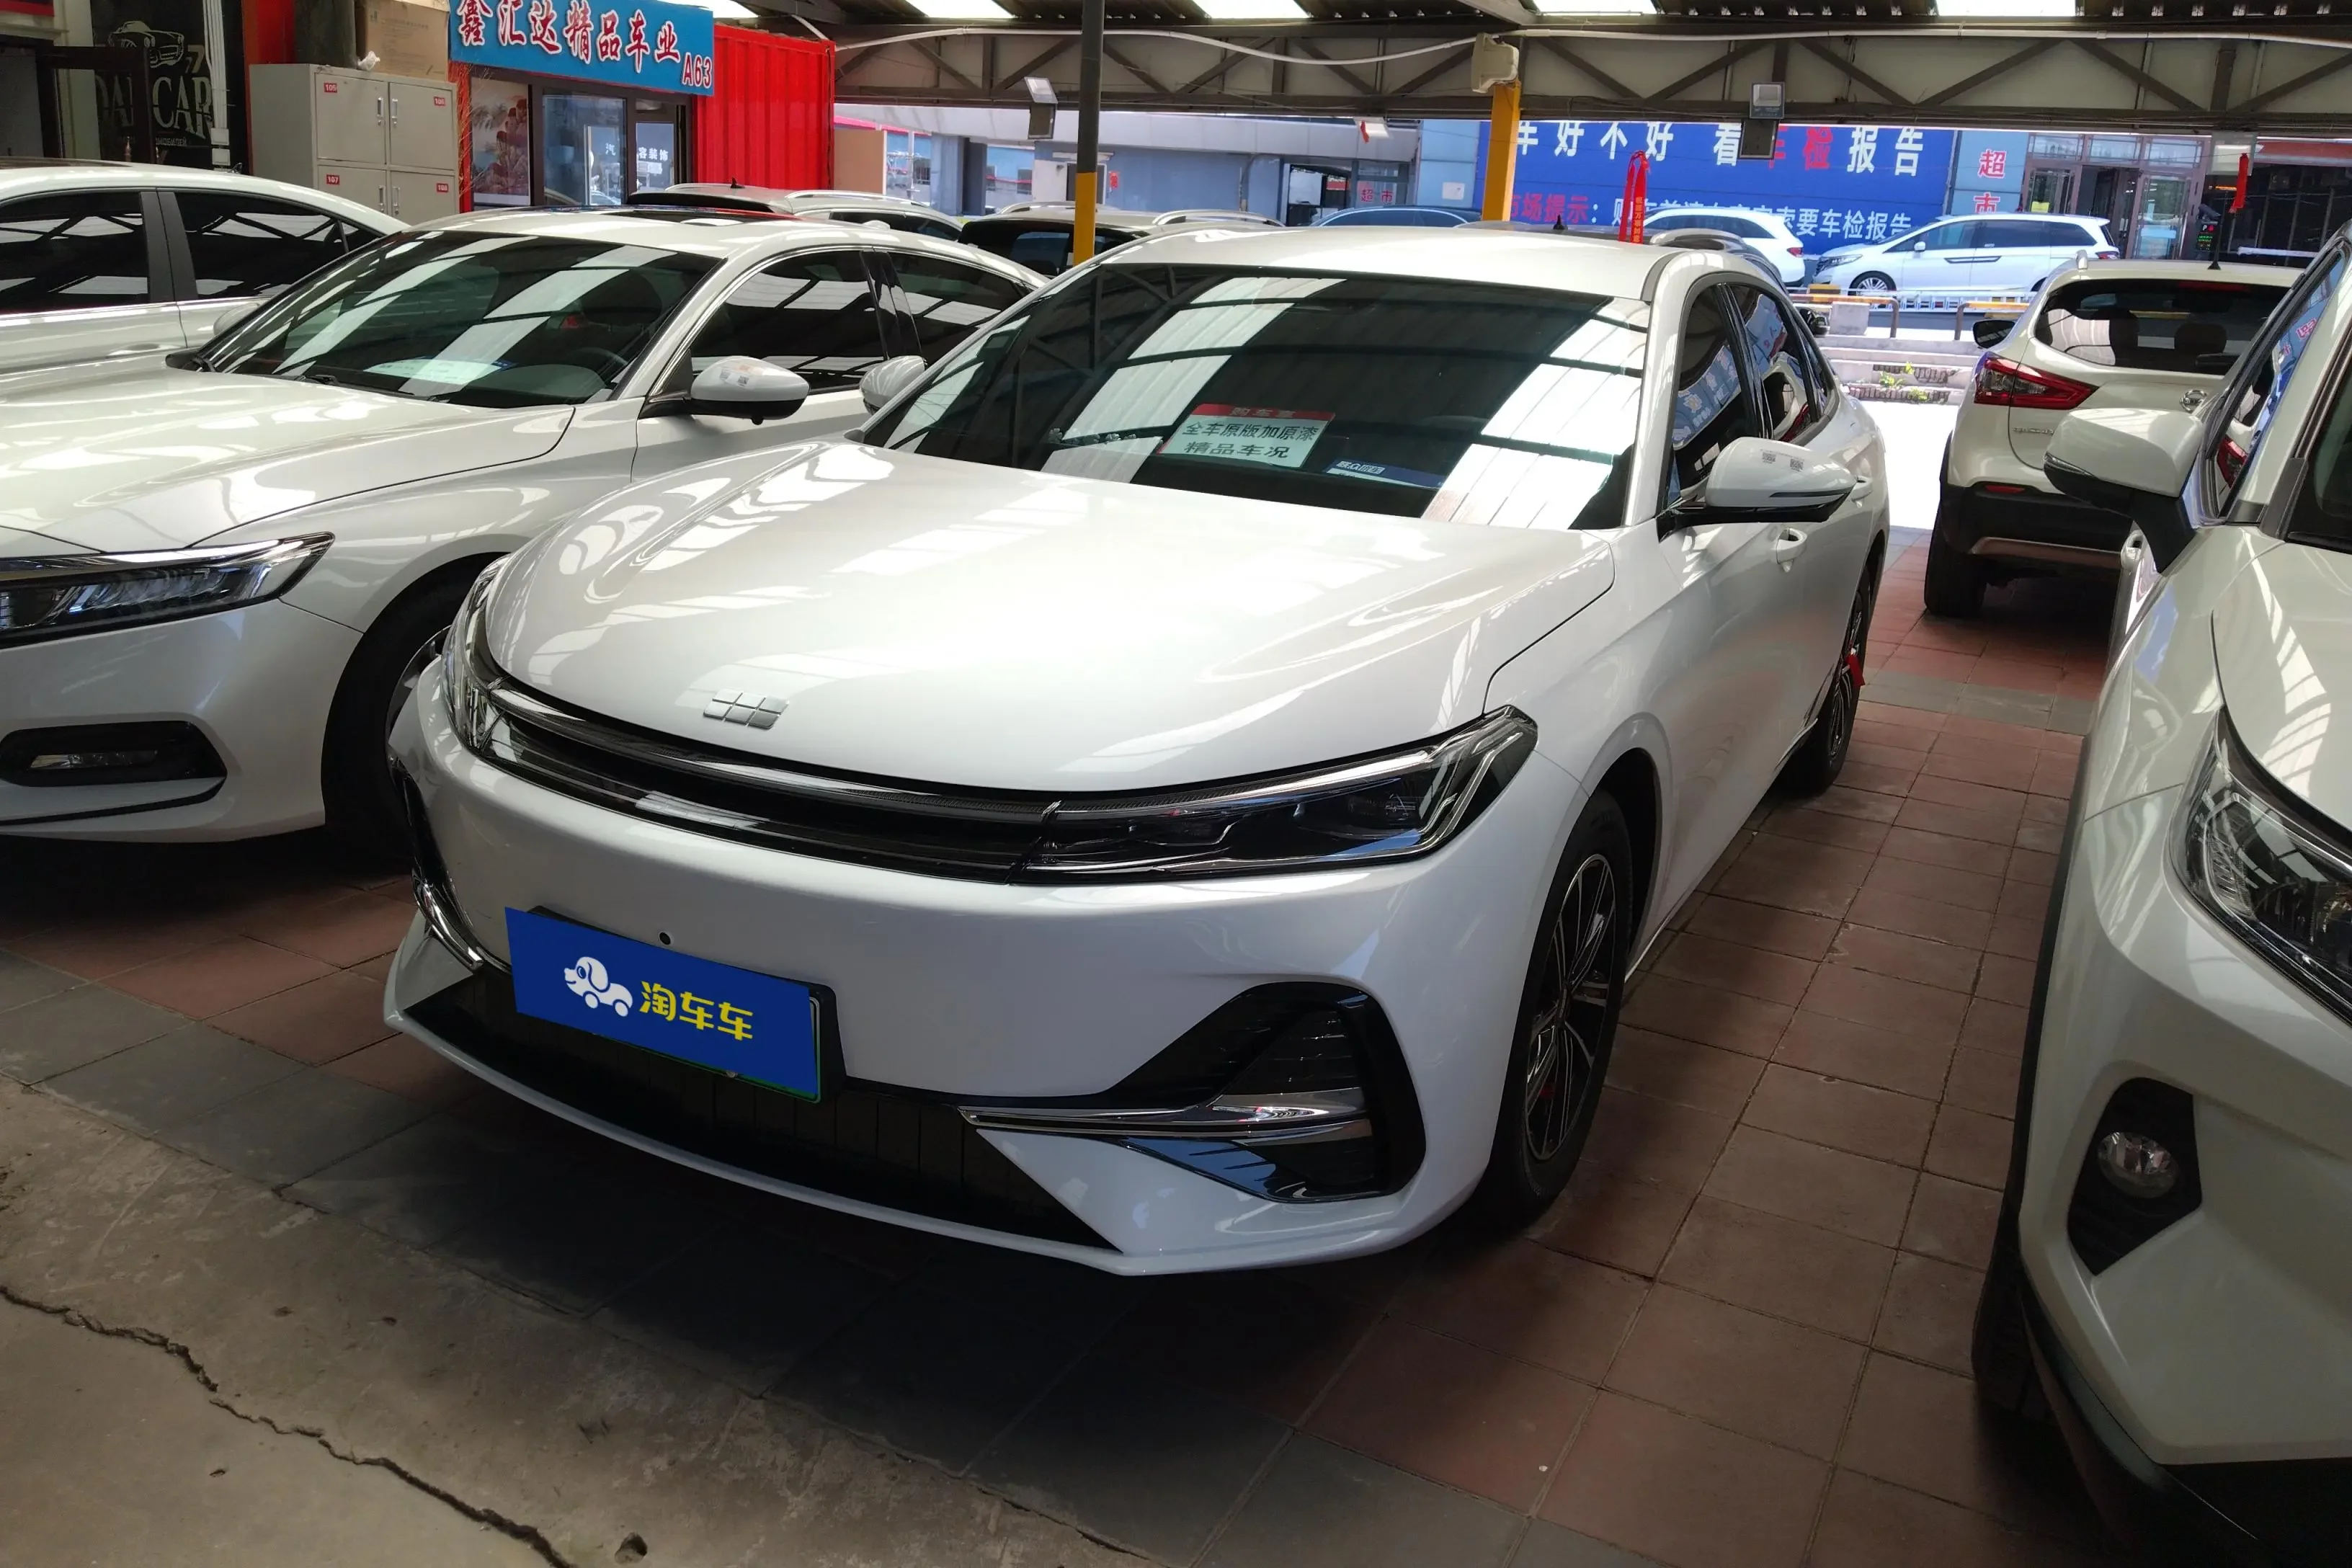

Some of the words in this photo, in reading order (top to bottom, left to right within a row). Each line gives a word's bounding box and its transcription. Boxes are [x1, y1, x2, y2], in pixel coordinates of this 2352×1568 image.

[458, 0, 680, 73] 鑫汇达精品车业
[682, 53, 713, 89] A63
[1360, 189, 1393, 202] 超市
[1182, 422, 1319, 442] 全车原版加原漆
[1184, 440, 1291, 459] 精品车况
